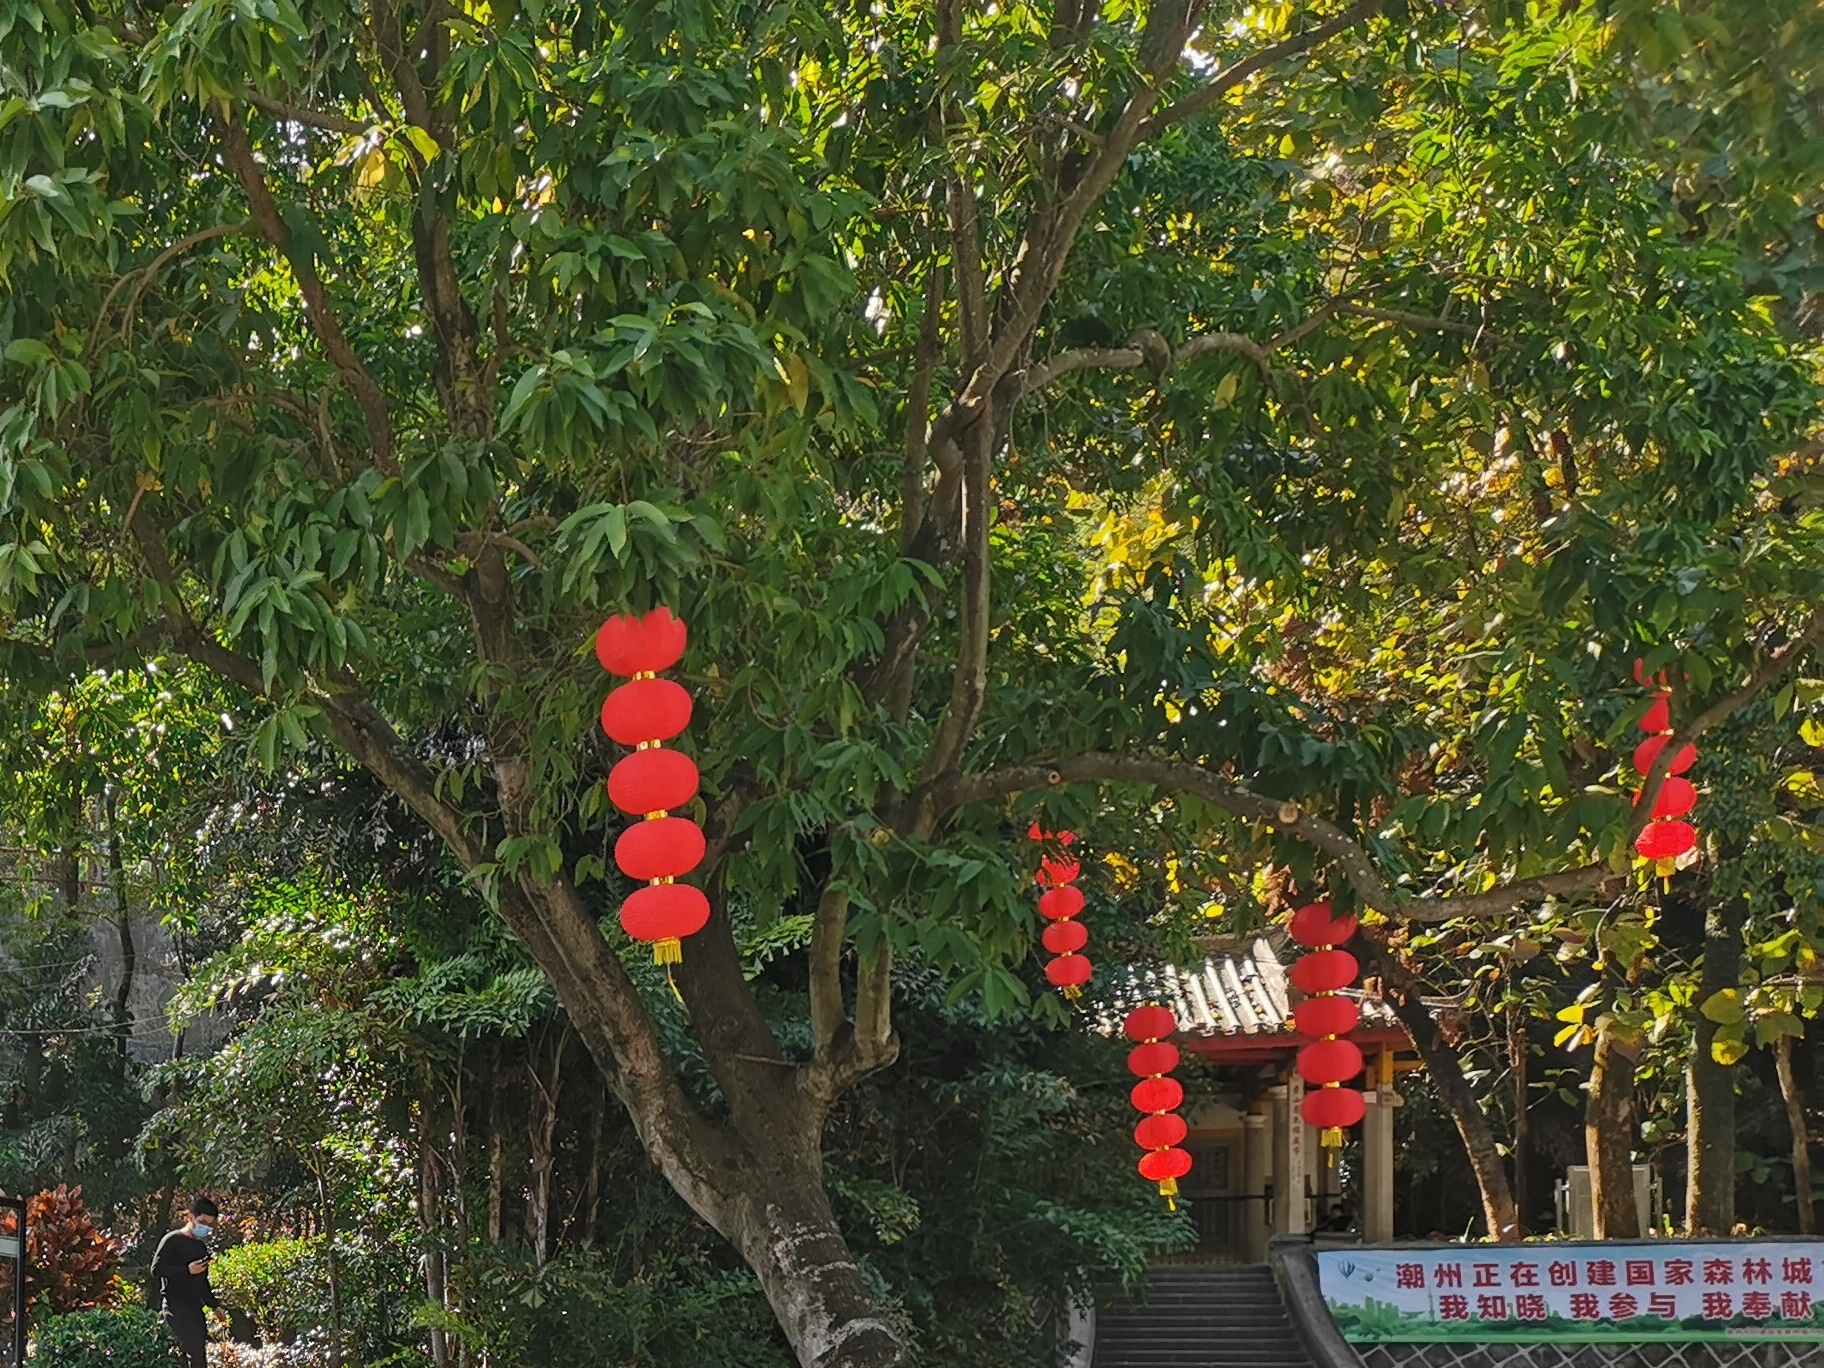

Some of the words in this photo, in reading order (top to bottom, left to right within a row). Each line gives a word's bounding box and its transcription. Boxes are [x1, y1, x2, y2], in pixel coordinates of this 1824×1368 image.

[1395, 1256, 1813, 1289] 潮州正在创建国家森林城
[1439, 1293, 1546, 1320] 我知晓
[1570, 1291, 1676, 1320] 我参与
[1702, 1290, 1813, 1319] 我奉献
